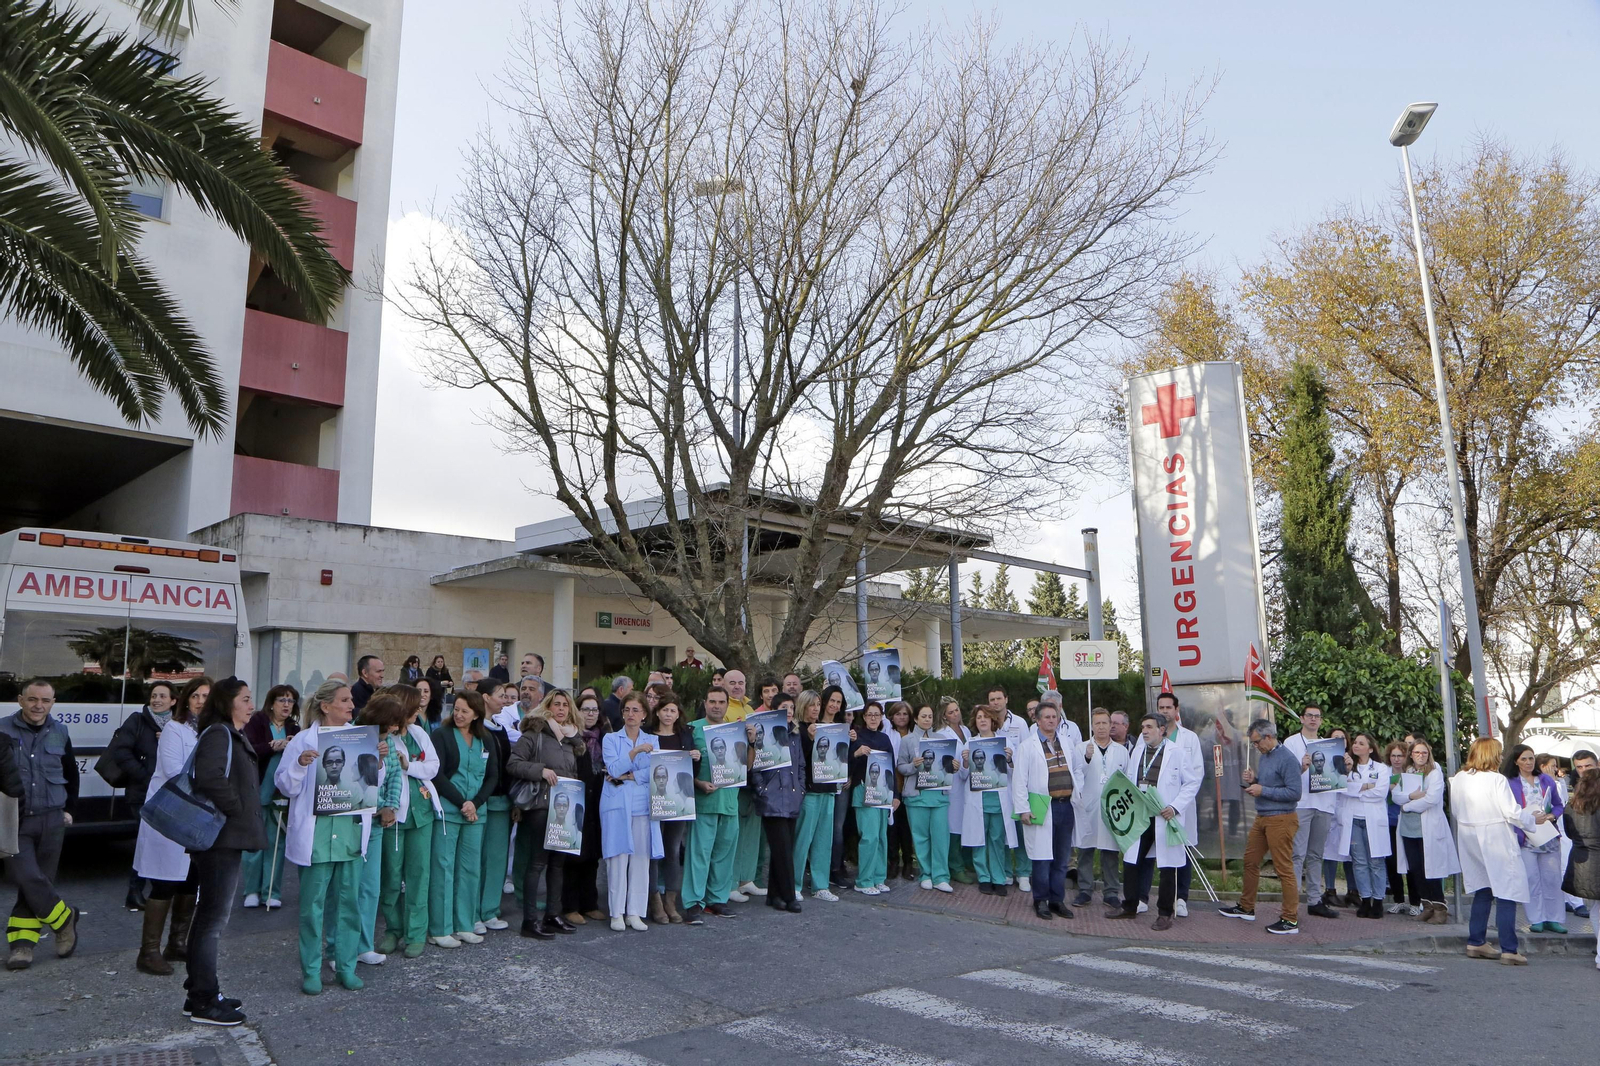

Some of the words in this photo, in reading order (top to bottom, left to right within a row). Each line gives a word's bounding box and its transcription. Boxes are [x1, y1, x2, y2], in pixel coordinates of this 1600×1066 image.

[1164, 452, 1201, 667] URGENCIAS
[17, 572, 232, 610] AMBULANCIA
[614, 616, 650, 628] URGENCIAS
[85, 714, 109, 724] 085
[1518, 728, 1566, 742] VALENZU
